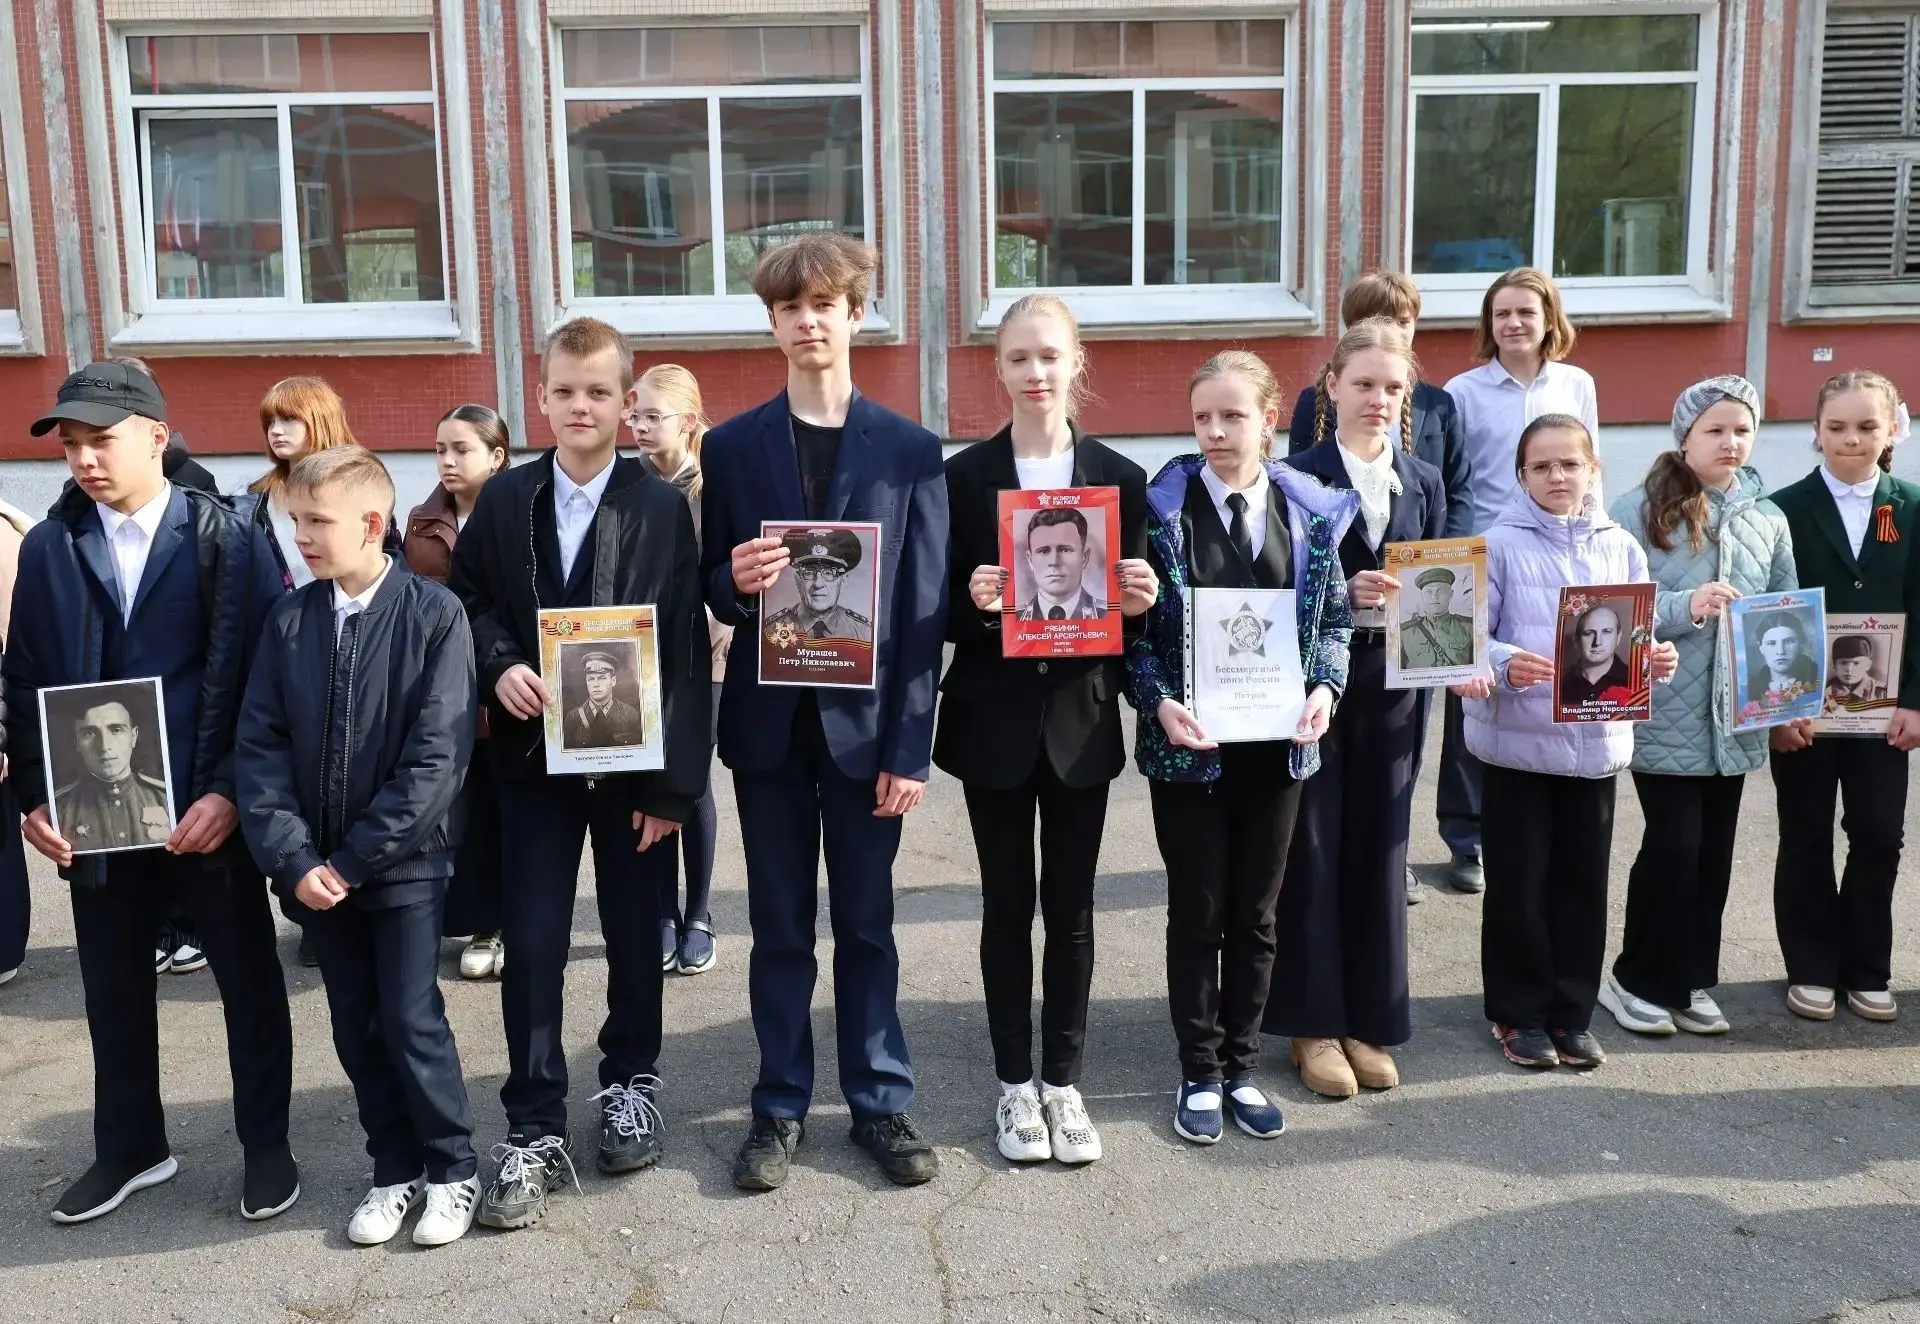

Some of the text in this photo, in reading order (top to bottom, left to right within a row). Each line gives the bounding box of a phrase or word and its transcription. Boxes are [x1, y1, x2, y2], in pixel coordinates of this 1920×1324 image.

[1044, 624, 1080, 632] РЯБИНИН
[1017, 631, 1108, 641] АЛЕКСЕЙ АРСЕНТЬЕВИЧ
[796, 648, 838, 658] Мурашев
[778, 657, 856, 668] Петр Николаевич
[1215, 664, 1281, 675] Бессмертный
[1220, 675, 1280, 685] полк России
[1582, 699, 1618, 707] Бегларян
[1562, 705, 1648, 715] Владимир Нерсесович
